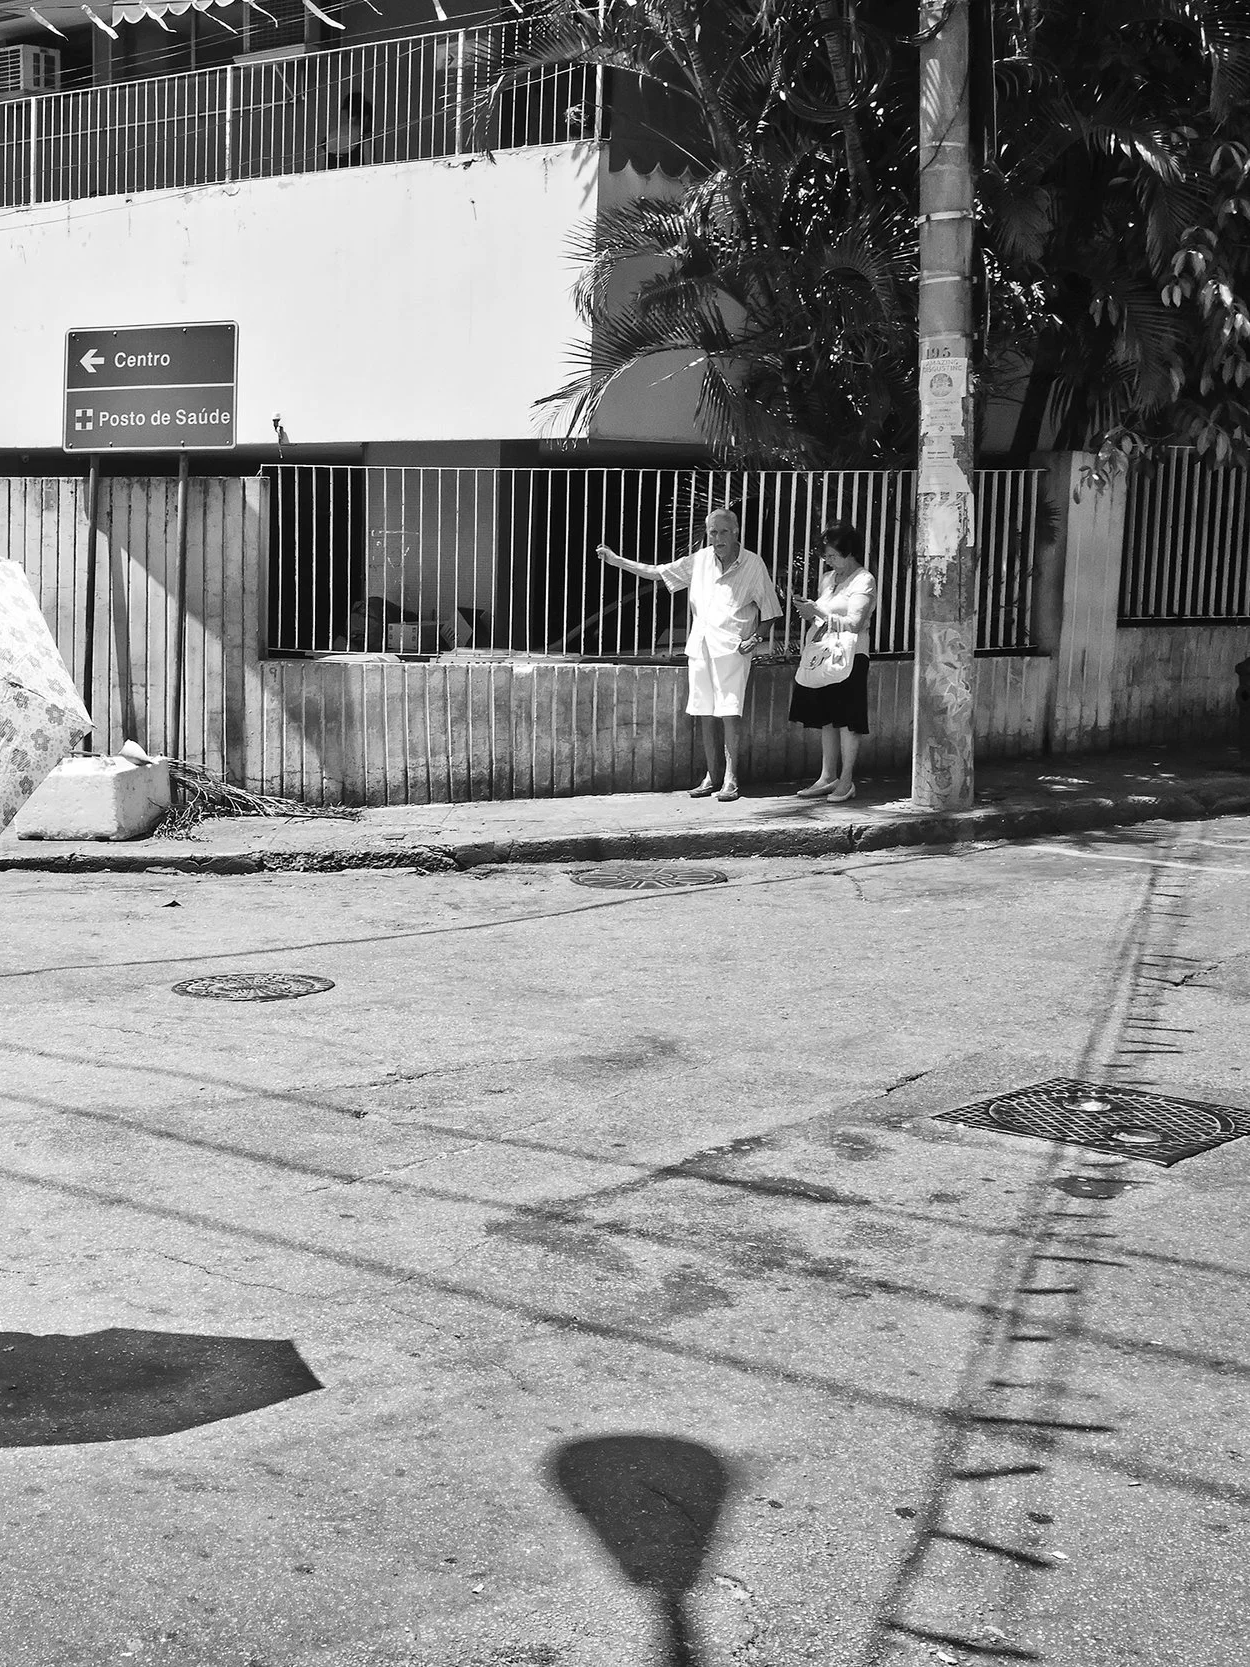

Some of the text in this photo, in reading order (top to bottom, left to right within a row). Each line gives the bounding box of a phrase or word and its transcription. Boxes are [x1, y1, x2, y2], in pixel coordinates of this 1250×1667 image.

[114, 351, 171, 368] Centro
[99, 407, 231, 427] Posto de Saúde
